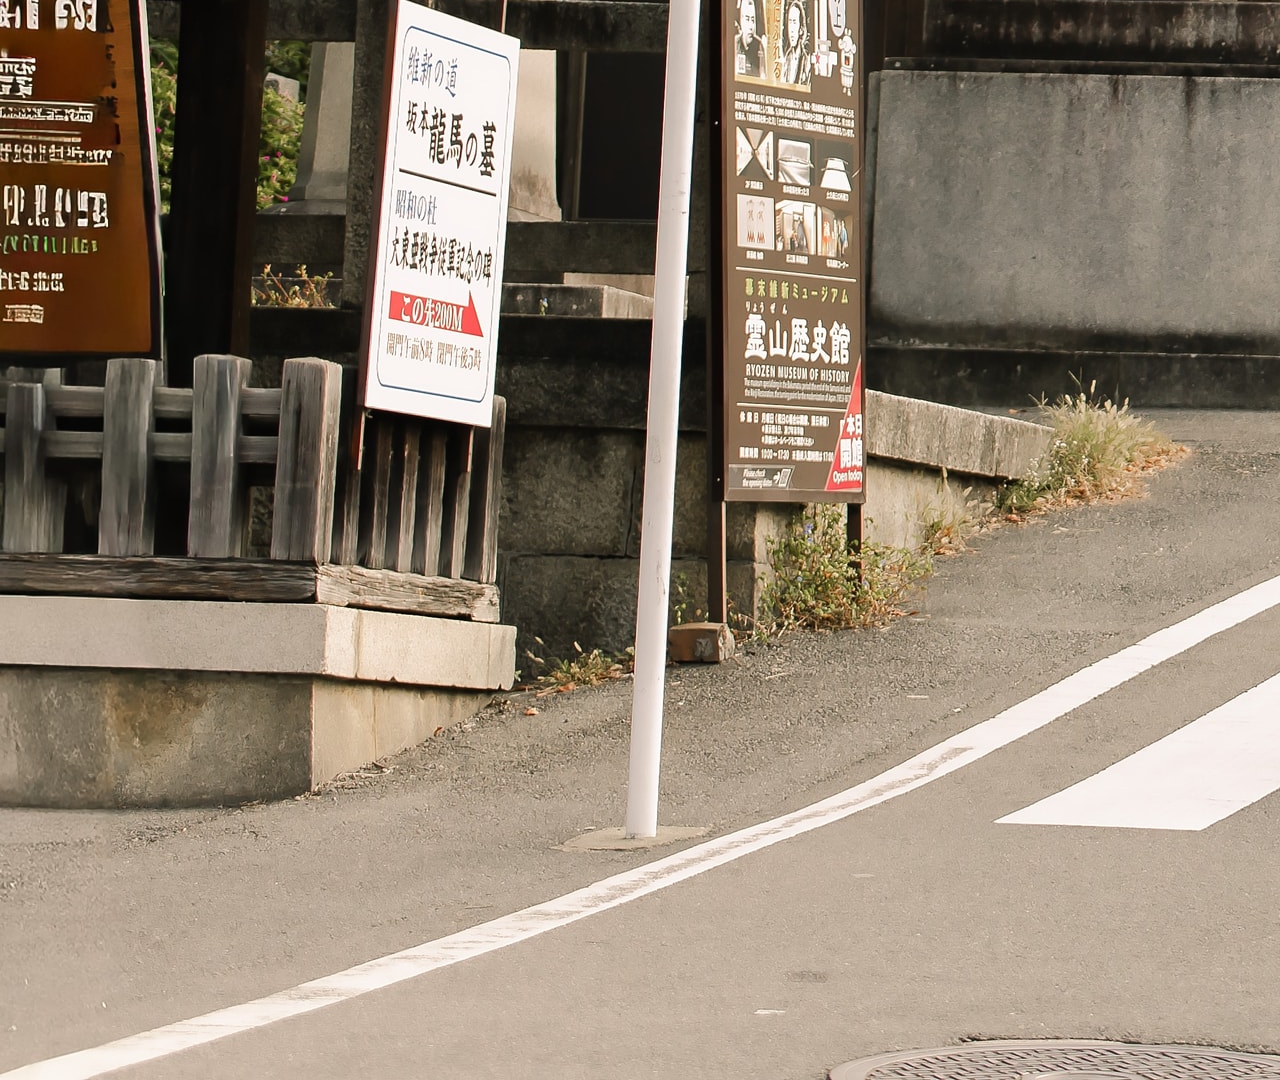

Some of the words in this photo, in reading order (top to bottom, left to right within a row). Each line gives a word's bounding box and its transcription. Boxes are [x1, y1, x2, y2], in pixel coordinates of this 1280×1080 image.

[407, 46, 458, 98] 維新の道
[406, 100, 497, 177] 坂本龍馬の墓
[395, 189, 438, 226] 昭和の杜
[745, 277, 849, 305] 幕末維新ミュージアム
[401, 295, 465, 332] この先200M
[744, 313, 851, 365] 霊山歴史館
[746, 363, 776, 378] RYOZEN
[778, 365, 808, 380] MUSEUM
[809, 368, 819, 381] OF
[820, 369, 850, 383] HISTORY
[833, 470, 849, 484] Open
